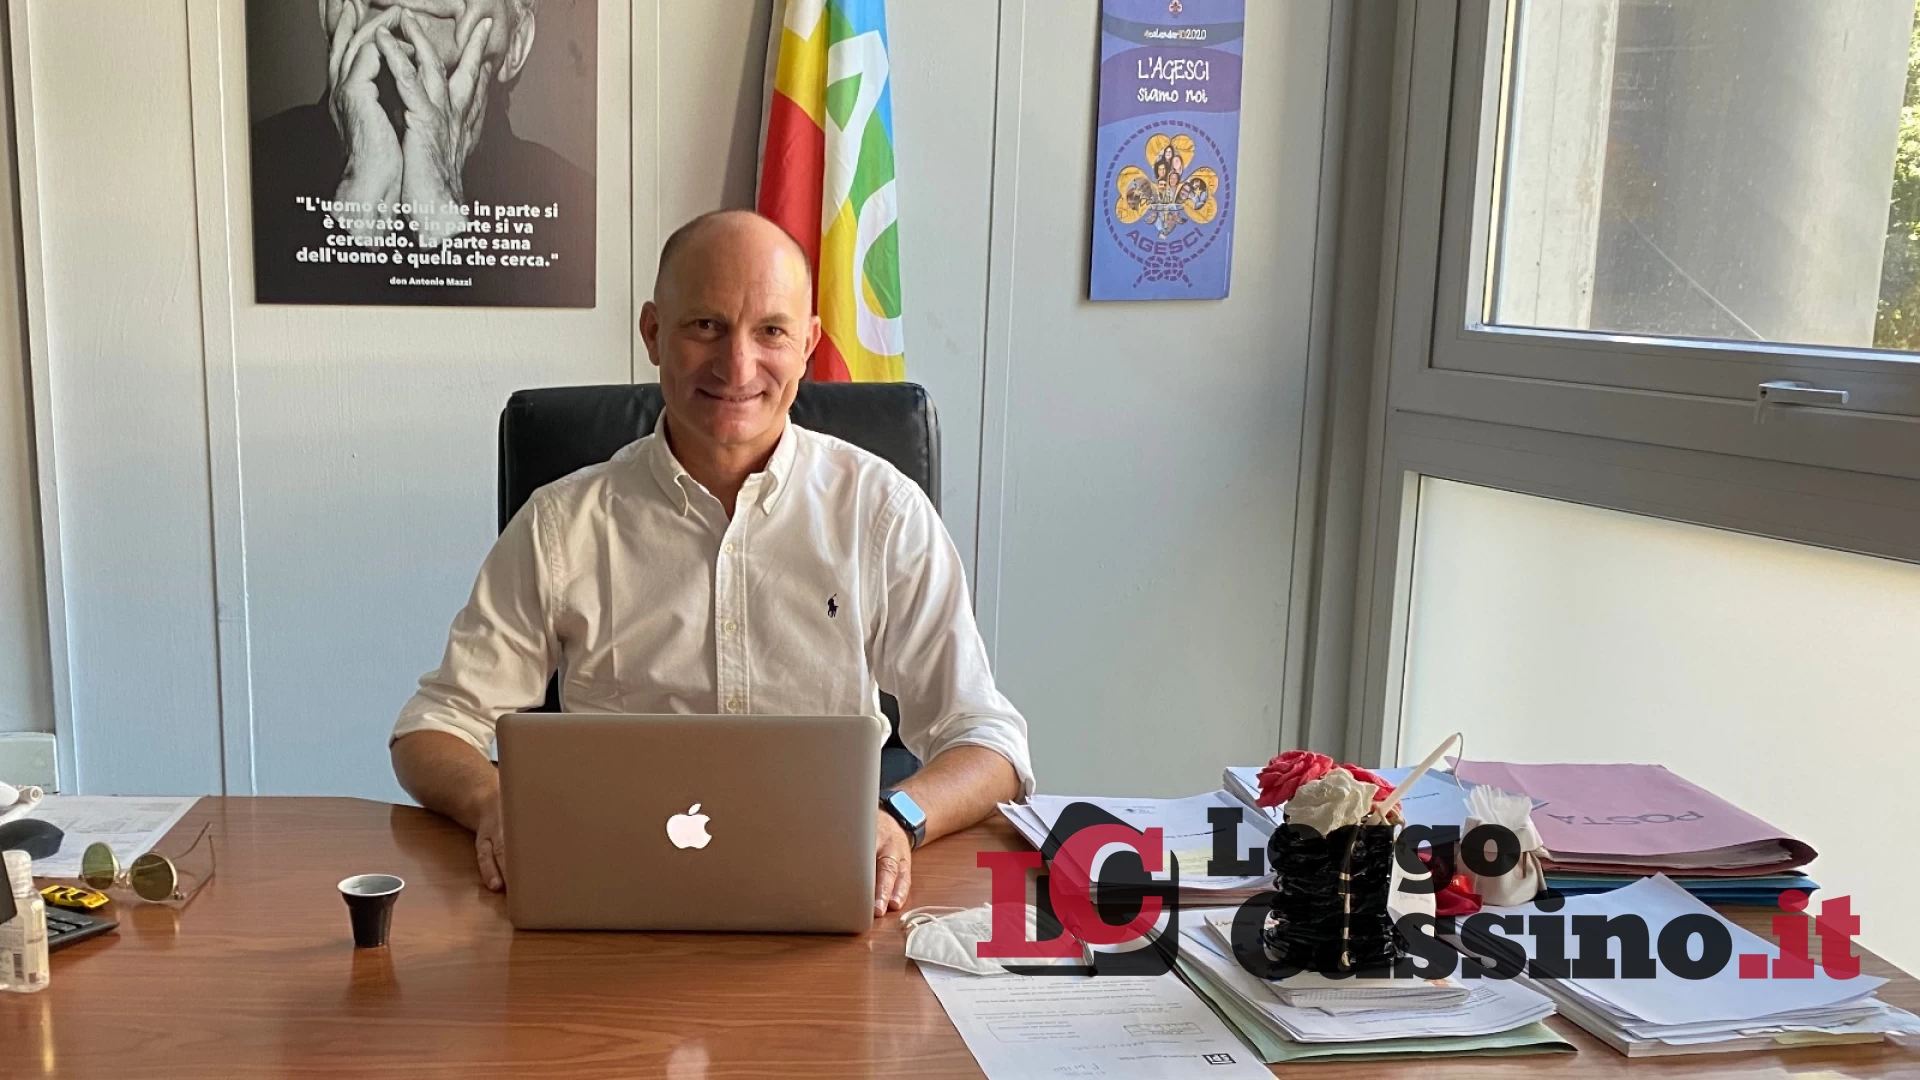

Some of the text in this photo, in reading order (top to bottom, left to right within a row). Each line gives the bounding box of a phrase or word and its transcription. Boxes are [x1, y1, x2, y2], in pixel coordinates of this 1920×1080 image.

[1138, 56, 1209, 85] L'AGESCI
[1137, 87, 1208, 103] siamo noi
[296, 196, 559, 221] "L'uomo è colui che in parte si
[323, 215, 534, 237] è trovato e in parte si va
[326, 233, 531, 253] cercando. La parte sana
[1125, 227, 1204, 256] AGESCI
[296, 247, 559, 268] dell'uomo è quella che cerca."
[389, 276, 473, 287] don Antonio Mazzi
[1547, 810, 1705, 825] POSTA
